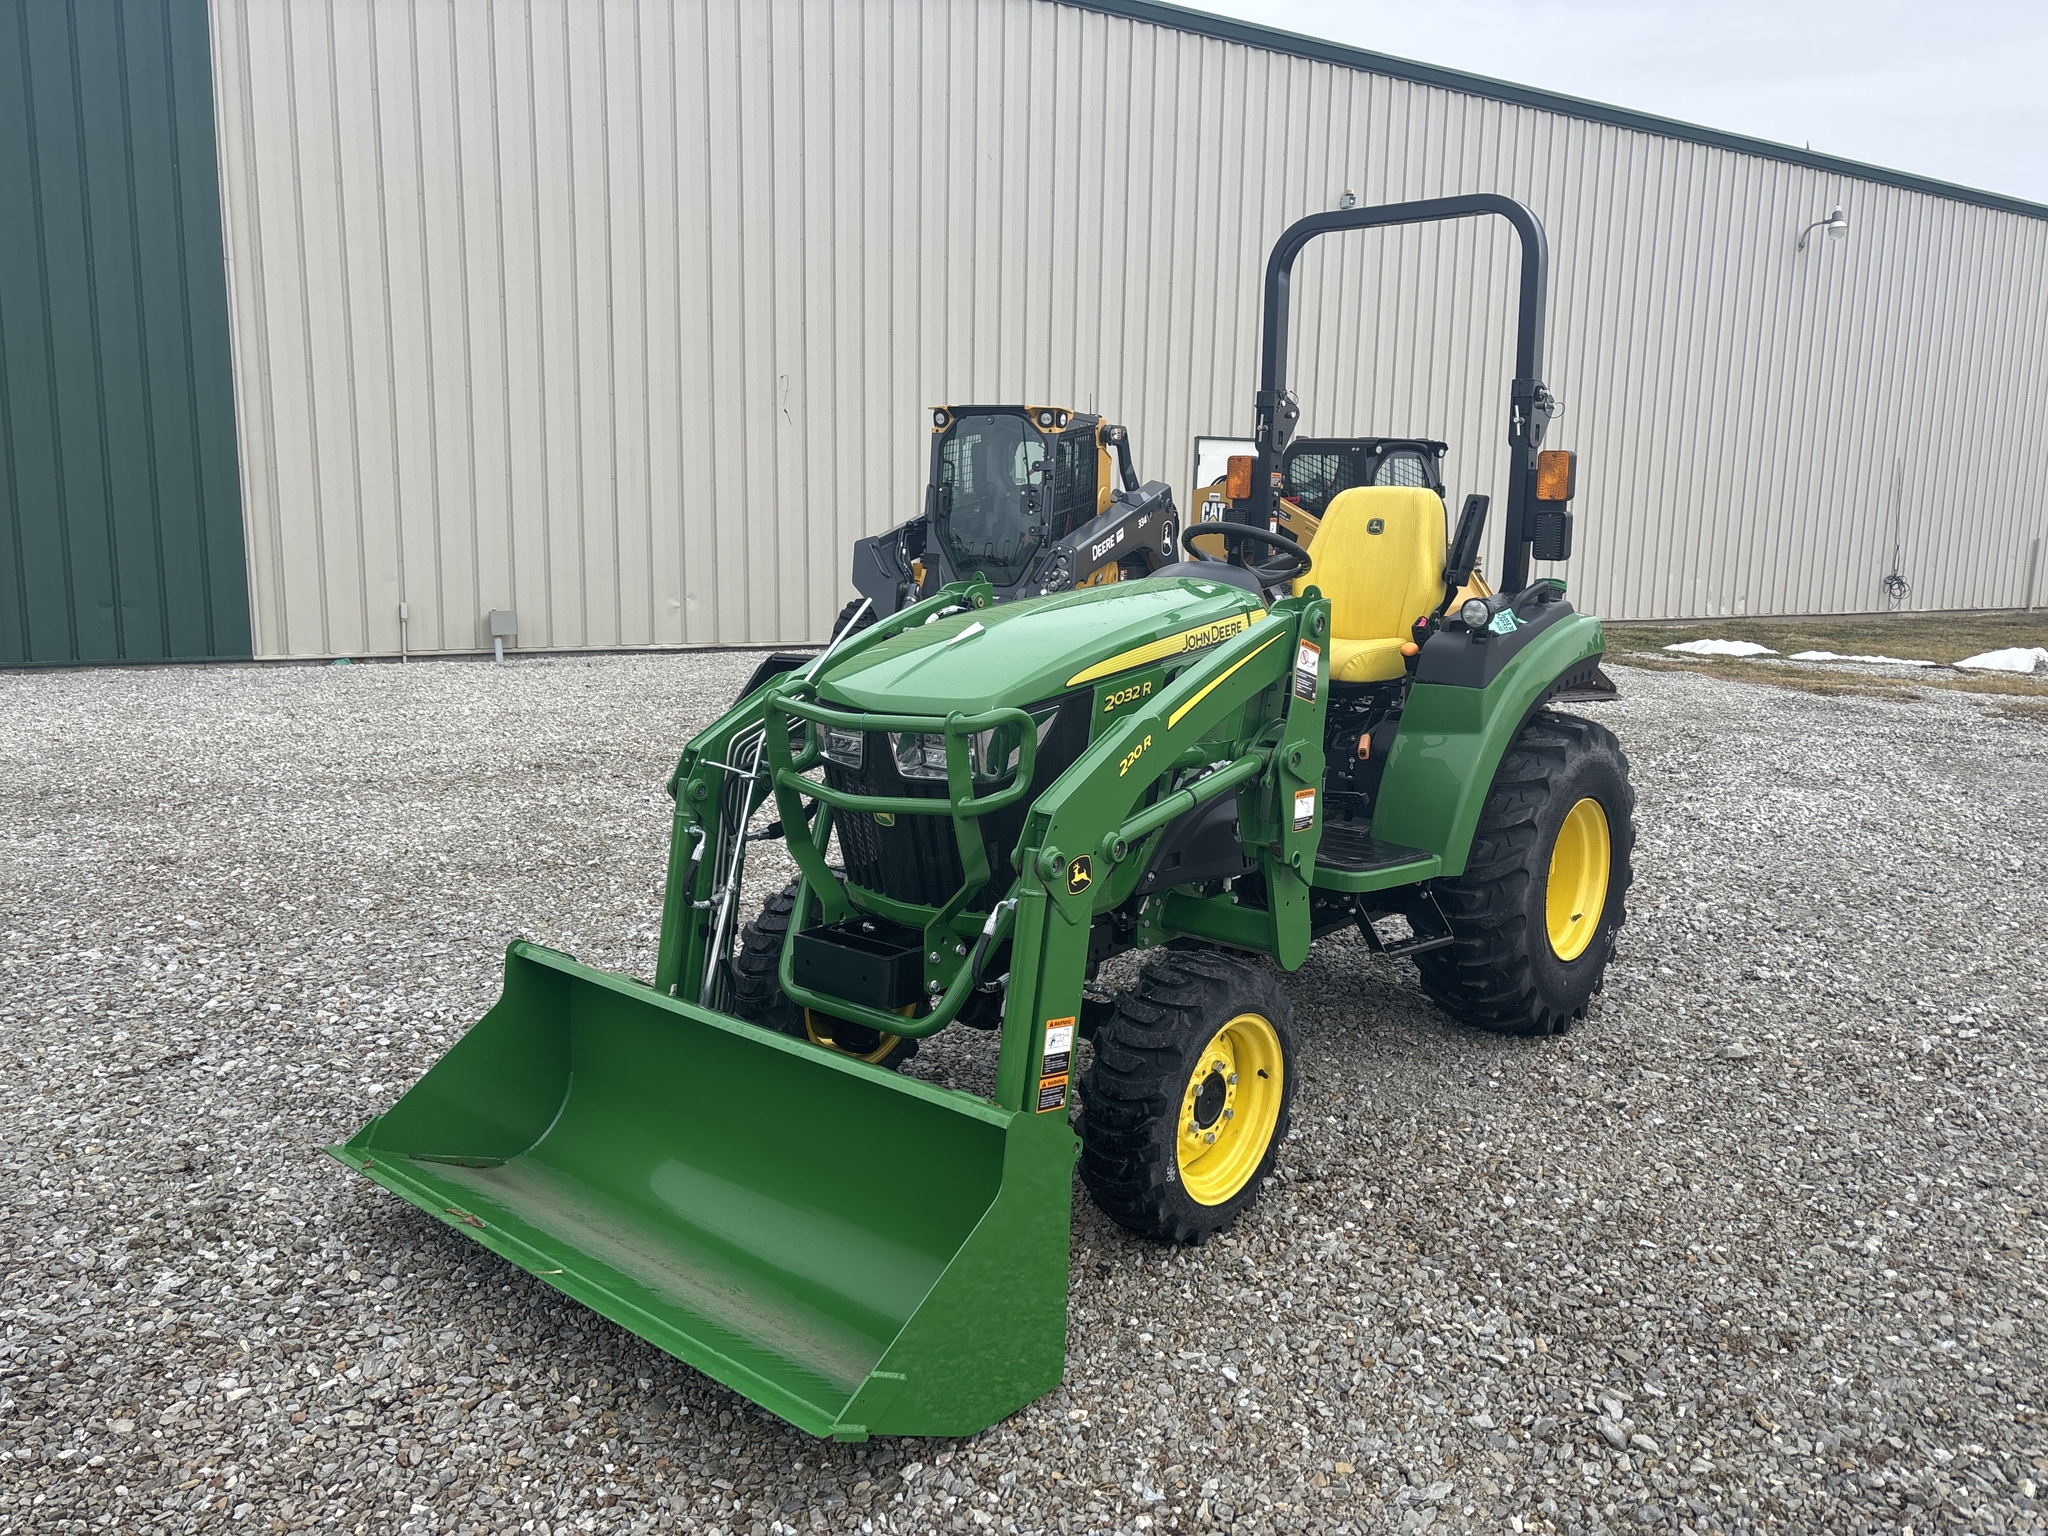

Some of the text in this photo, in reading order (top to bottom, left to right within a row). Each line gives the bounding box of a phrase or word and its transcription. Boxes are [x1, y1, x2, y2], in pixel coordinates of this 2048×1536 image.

[1201, 501, 1226, 523] CAT
[1092, 533, 1116, 562] DEERE
[1182, 621, 1243, 652] JOHN DEERE
[1103, 681, 1152, 712] 2032 R
[1119, 734, 1152, 778] 220 R
[1054, 1019, 1072, 1027] WARNING
[1047, 1077, 1066, 1087] WARNING
